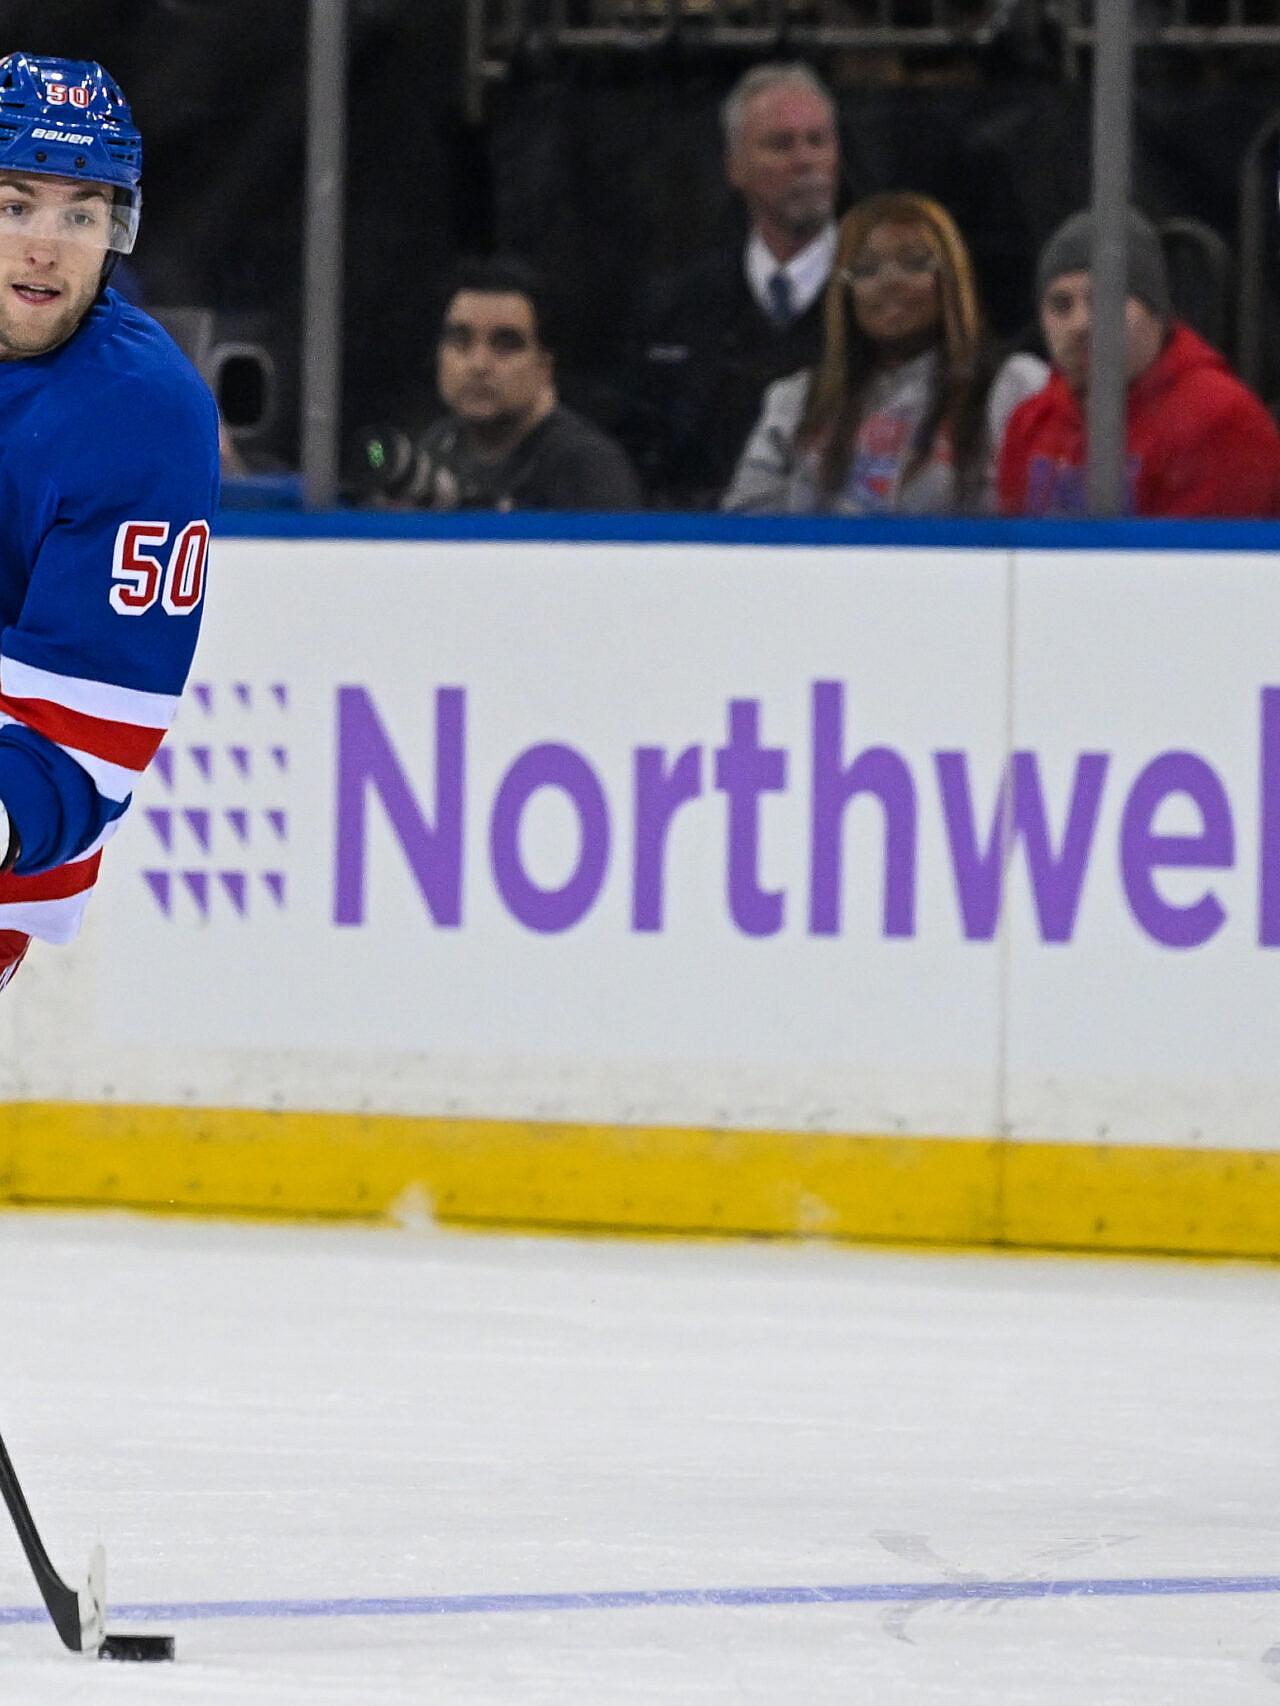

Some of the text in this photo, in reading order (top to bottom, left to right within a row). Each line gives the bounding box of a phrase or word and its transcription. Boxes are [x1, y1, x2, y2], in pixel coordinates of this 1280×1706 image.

[46, 84, 89, 108] 50
[31, 128, 95, 146] BAUER
[109, 519, 210, 616] 50
